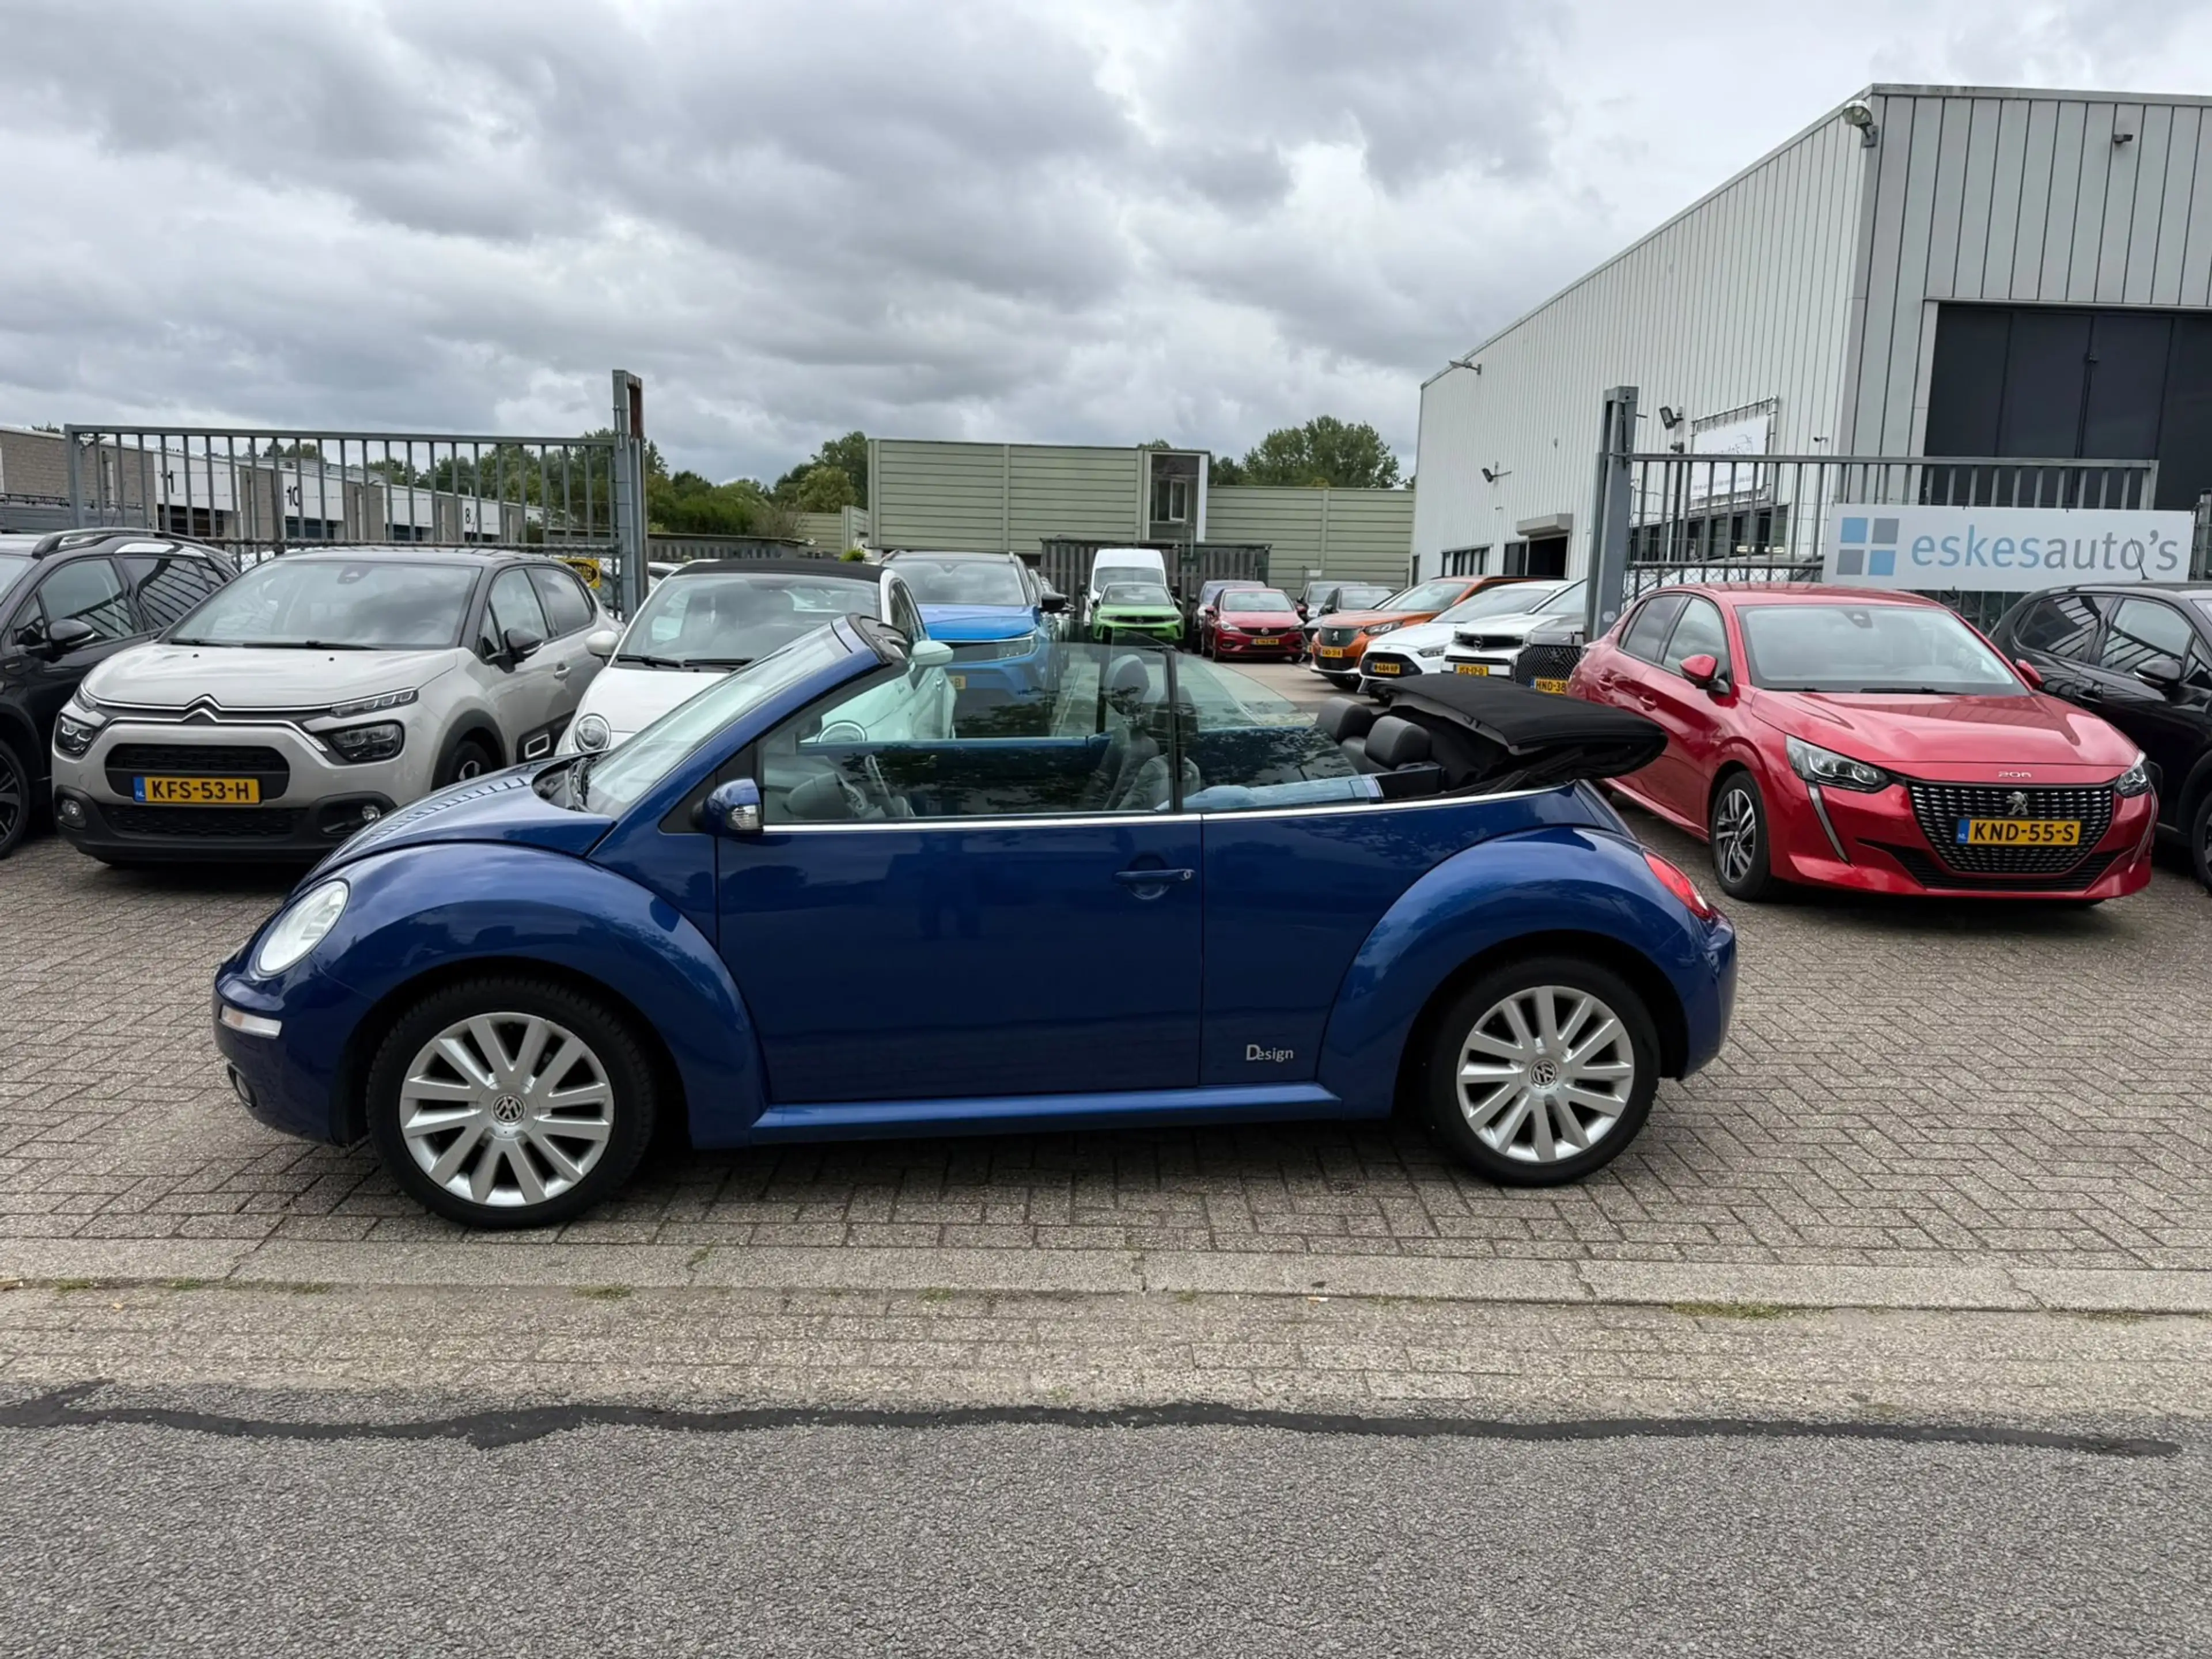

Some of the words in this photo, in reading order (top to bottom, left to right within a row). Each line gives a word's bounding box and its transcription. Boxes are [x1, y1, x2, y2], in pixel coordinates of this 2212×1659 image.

[465, 507, 471, 524] 8
[151, 780, 249, 800] KFS-53-H
[1974, 822, 2075, 842] KND-55-S
[1246, 1044, 1294, 1063] Design
